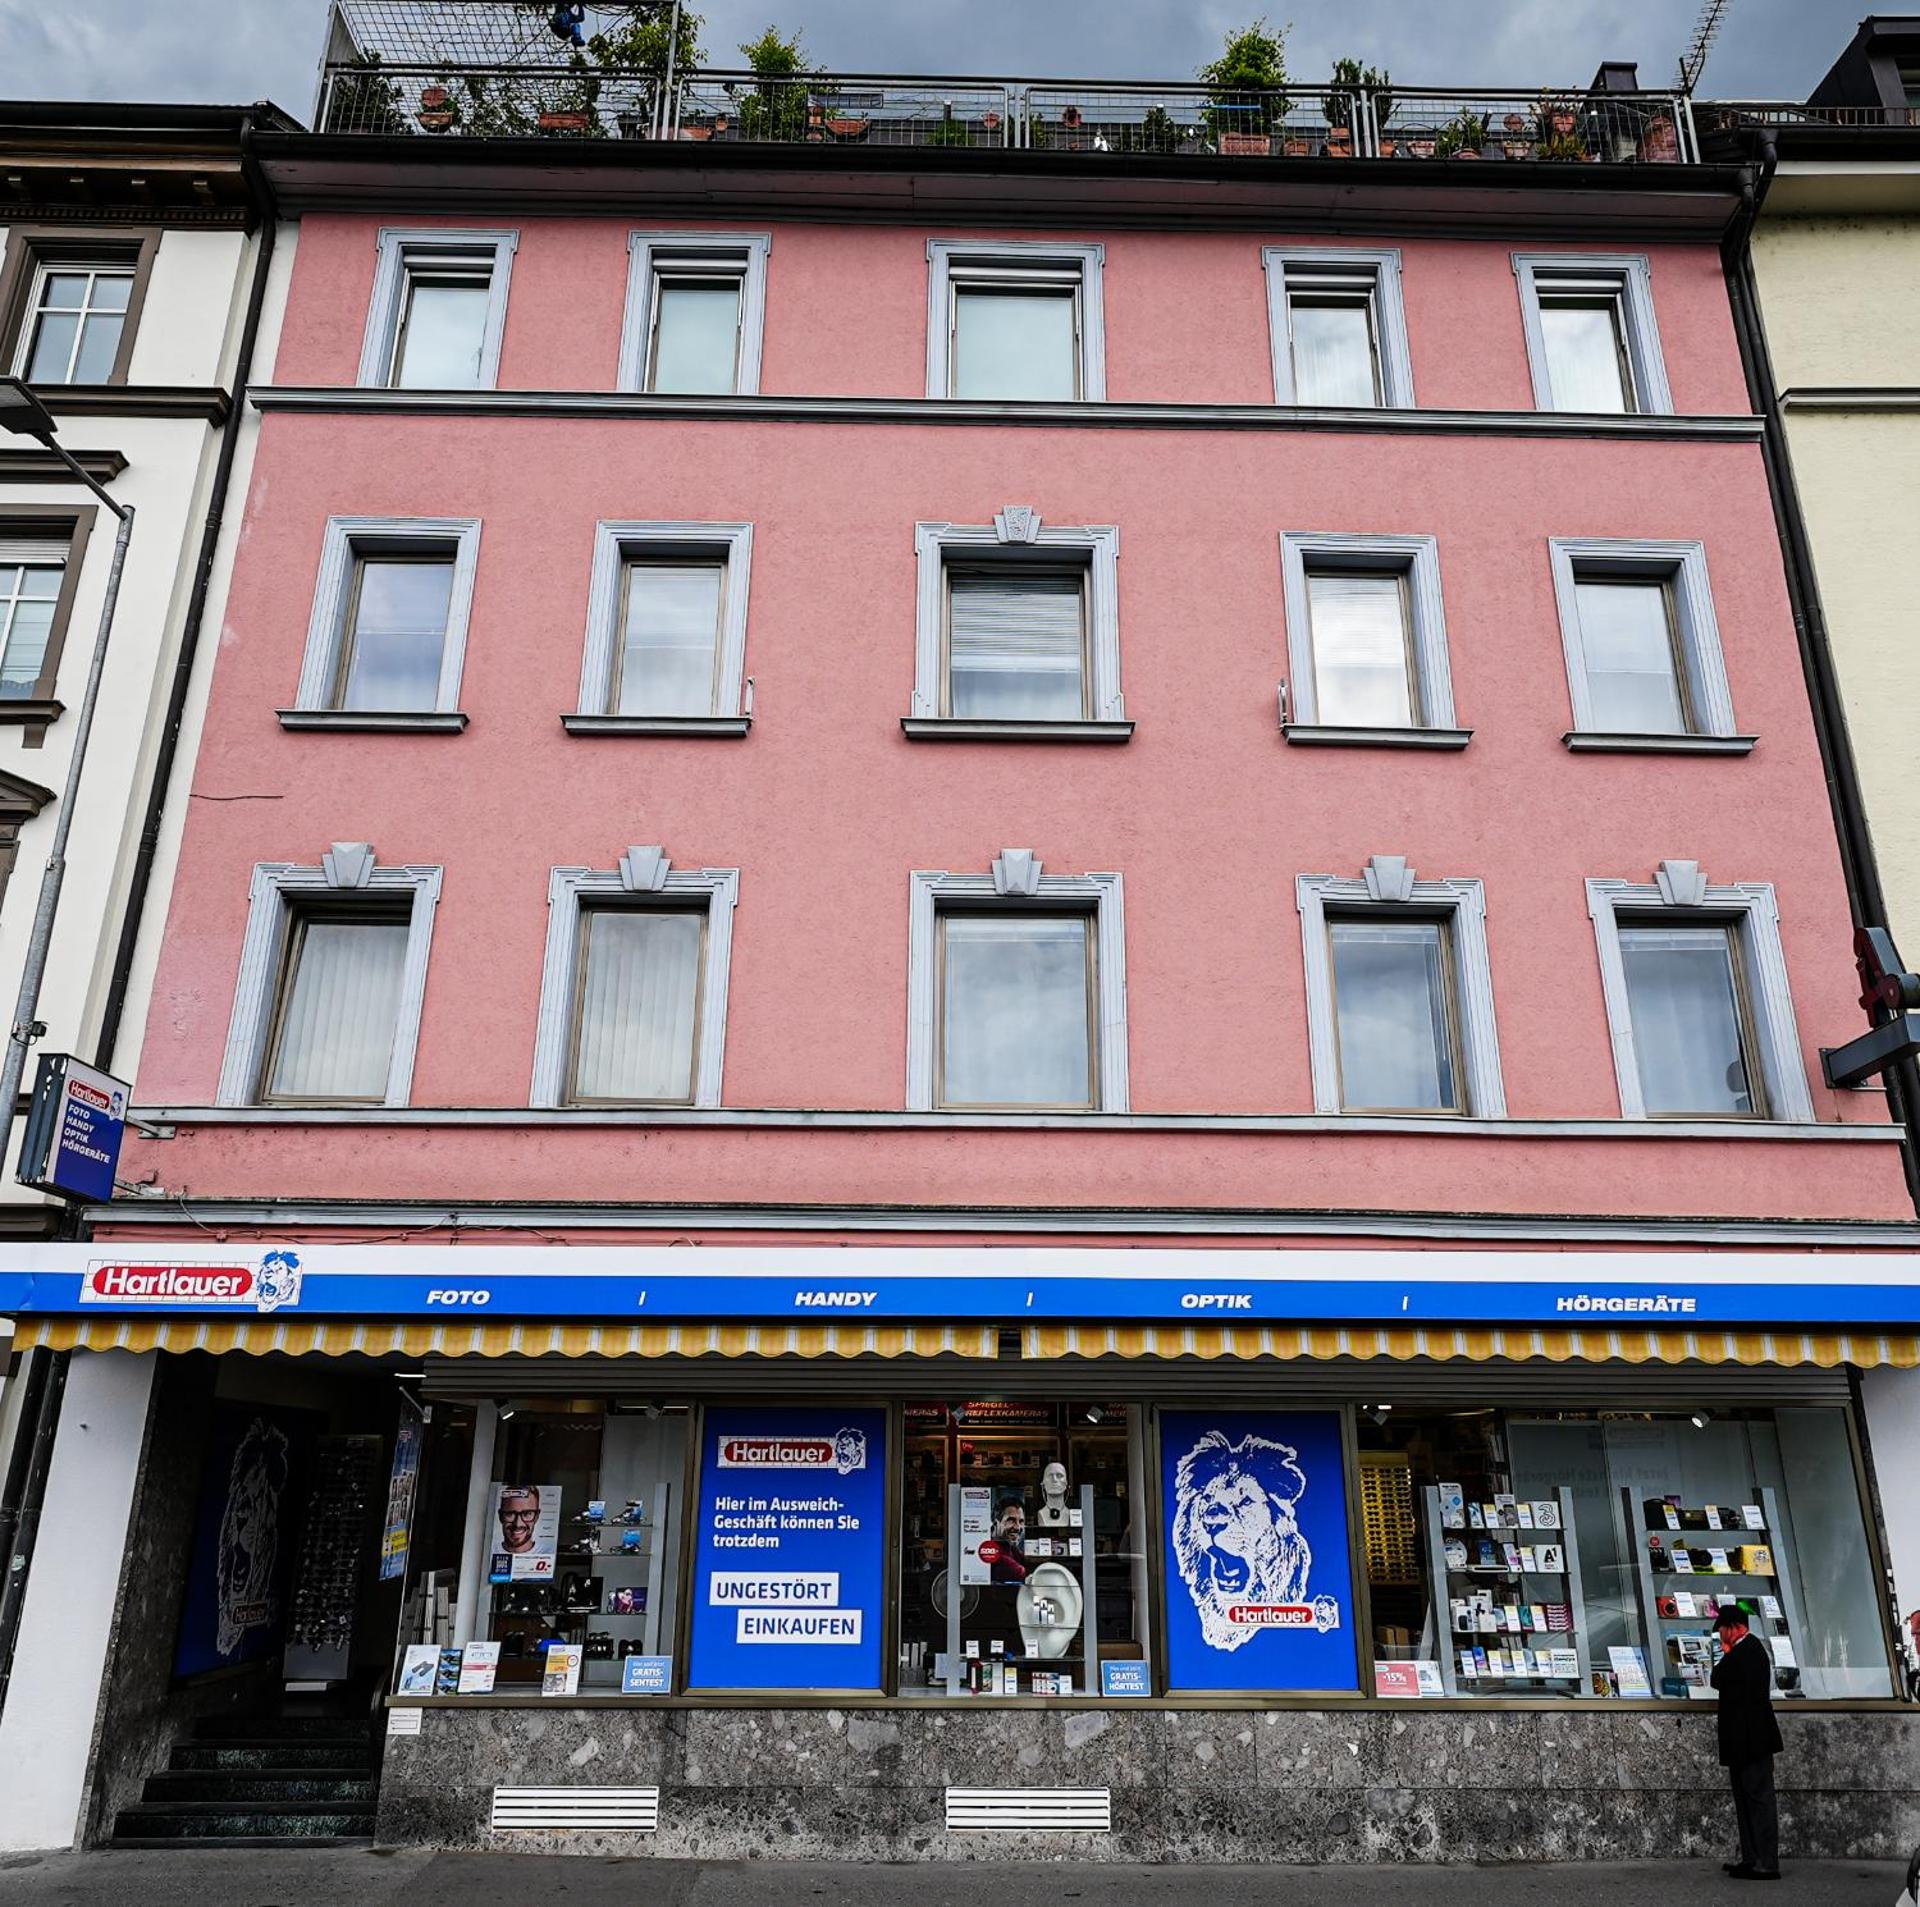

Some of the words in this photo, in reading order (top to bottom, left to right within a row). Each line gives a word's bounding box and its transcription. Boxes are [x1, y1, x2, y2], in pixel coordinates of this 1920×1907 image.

[69, 1081, 108, 1109] Hartlauer
[68, 1104, 90, 1119] FOTO
[66, 1115, 95, 1132] HANDY
[64, 1127, 89, 1143] OPTIK
[61, 1139, 111, 1163] HÖRGERÄTE
[103, 1267, 243, 1296] Hartlauer
[426, 1290, 490, 1305] FOTO
[795, 1292, 877, 1306] HANDY
[1181, 1294, 1252, 1309] OPTIK
[1556, 1294, 1697, 1312] HÖRGERÄTE
[732, 1443, 825, 1462] Hartlauer
[715, 1497, 746, 1511] Hier
[748, 1497, 767, 1511] im
[770, 1497, 845, 1511] Ausweich-
[714, 1514, 777, 1529] Geschäft
[780, 1515, 834, 1529] können
[837, 1515, 860, 1529] Sie
[713, 1533, 779, 1548] trotzdem
[717, 1578, 832, 1599] UNGESTÖRT
[1234, 1606, 1308, 1624] Hartlauer
[744, 1617, 855, 1635] EINKAUFEN
[632, 1668, 664, 1677] GRATIS-
[1110, 1672, 1142, 1681] GRATIS-
[1108, 1681, 1145, 1690] HÖRTEST
